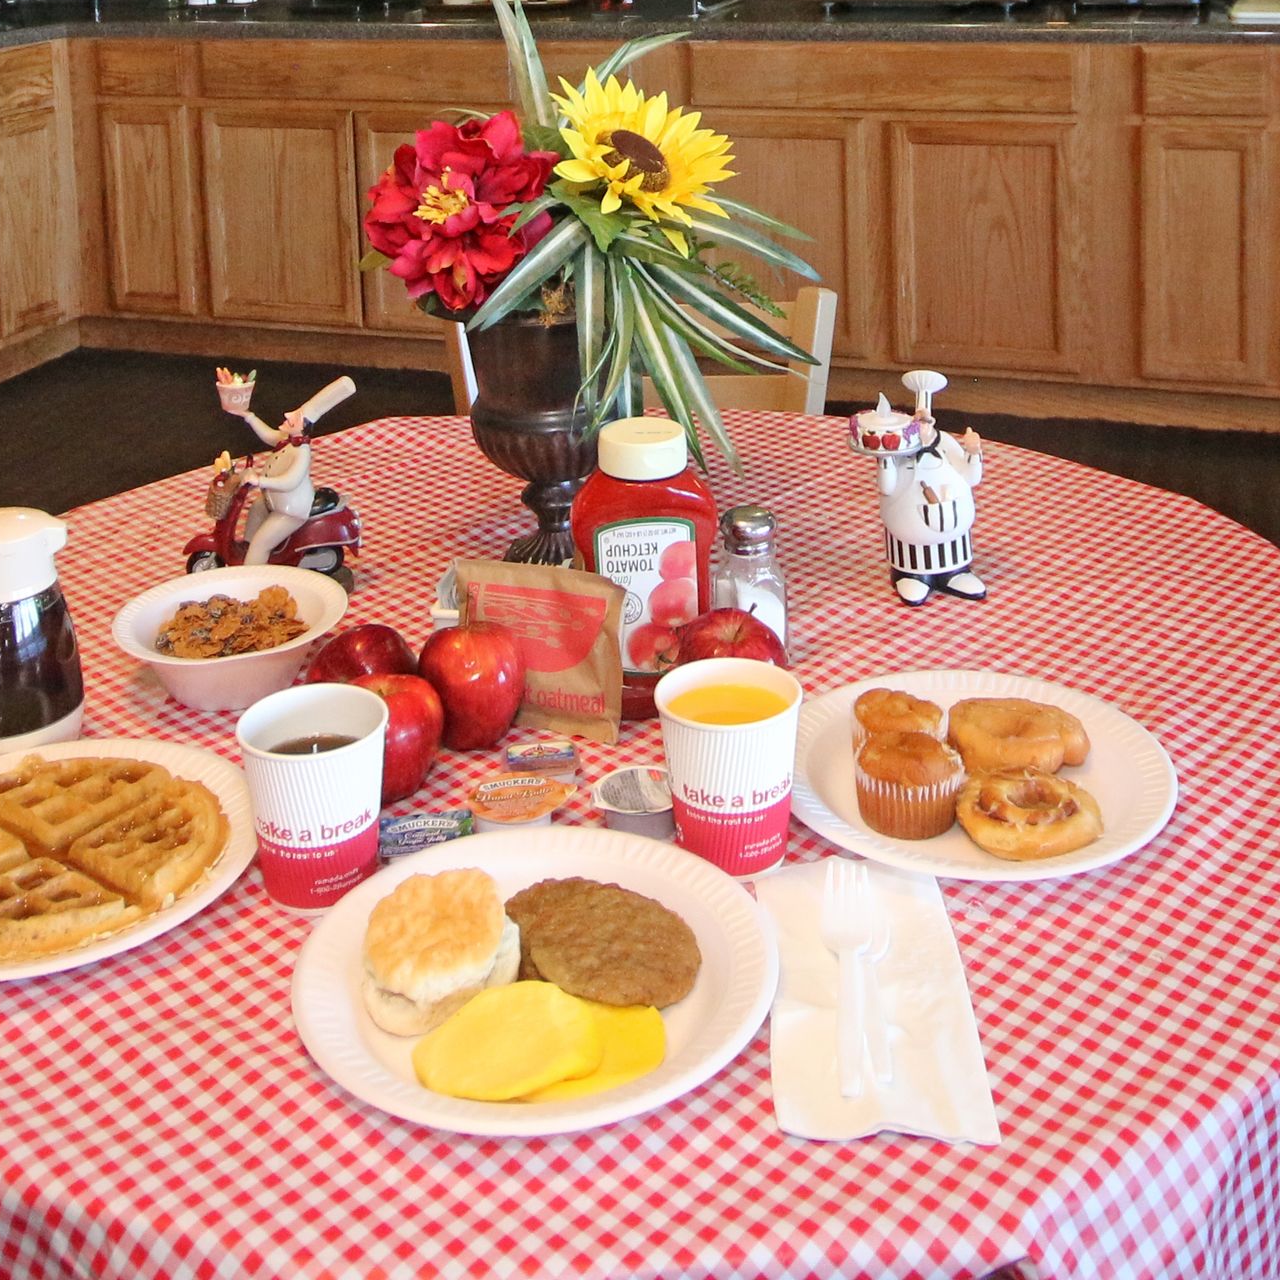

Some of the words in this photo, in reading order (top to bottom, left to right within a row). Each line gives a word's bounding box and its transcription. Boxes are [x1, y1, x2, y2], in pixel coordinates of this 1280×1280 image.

[605, 542, 658, 558] KETCHUP
[606, 560, 654, 574] TOMATO
[537, 689, 605, 714] oatmeal
[683, 783, 725, 808] take
[731, 795, 744, 808] a
[298, 829, 312, 842] a
[321, 808, 372, 840] break
